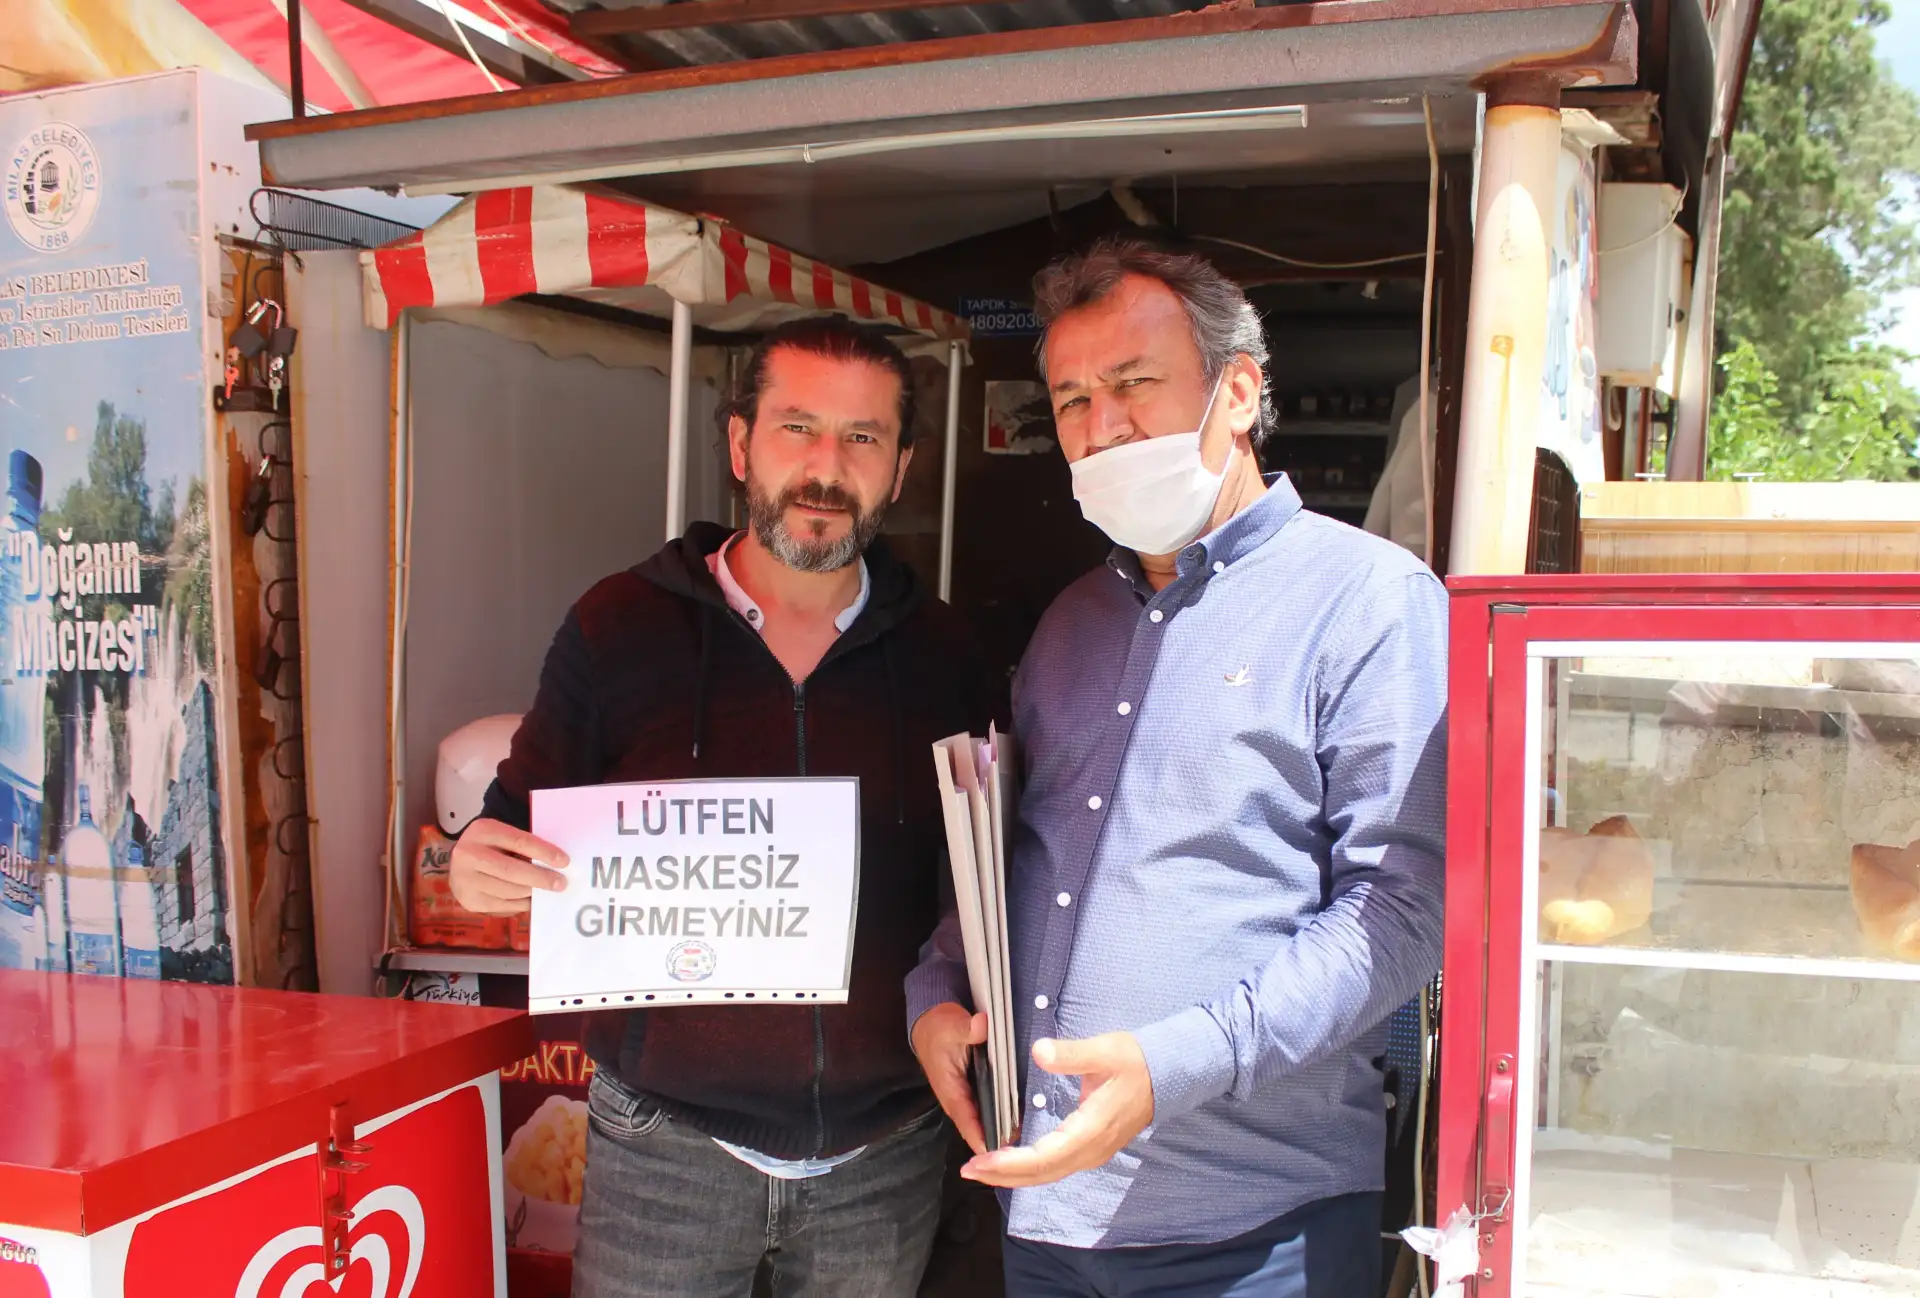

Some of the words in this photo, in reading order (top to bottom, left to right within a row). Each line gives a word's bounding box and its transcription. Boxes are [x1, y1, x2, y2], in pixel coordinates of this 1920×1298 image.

[40, 231, 69, 247] 1868
[31, 259, 148, 296] BELEDİYESİ
[19, 298, 90, 325] İştirakler
[95, 287, 182, 313] Müdürlüğü
[967, 299, 1006, 310] TAPDK
[12, 326, 36, 347] Pet
[42, 323, 62, 344] Su
[68, 322, 119, 342] Dolum
[126, 311, 190, 336] Tesisleri
[8, 527, 141, 610] "Doğanın
[616, 790, 774, 836] LÜTFEN
[591, 845, 800, 890] MASKESİZ
[575, 897, 810, 938] GİRMEYİNİZ
